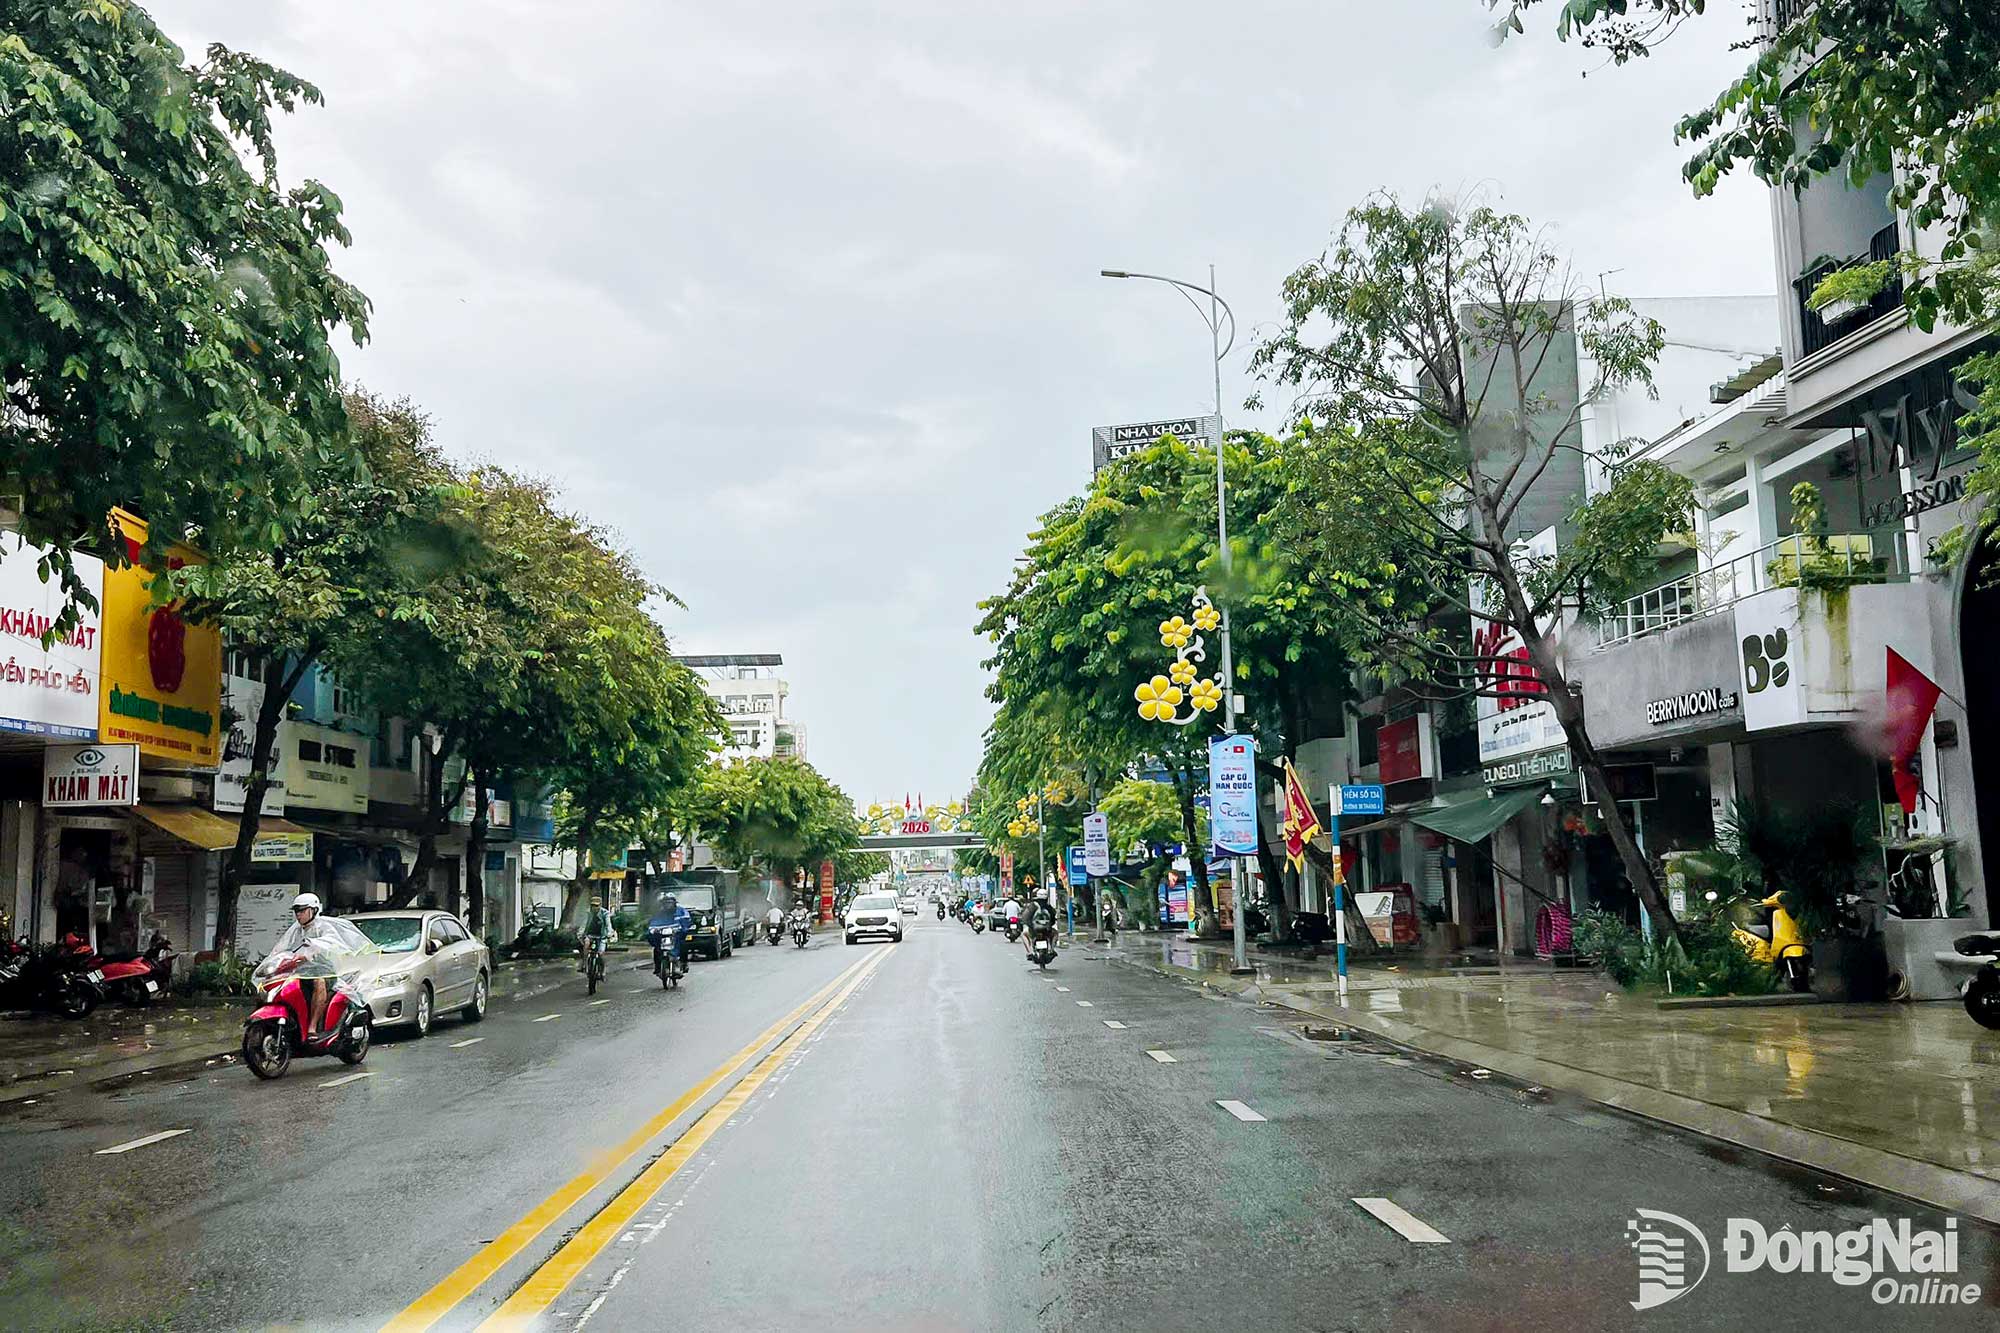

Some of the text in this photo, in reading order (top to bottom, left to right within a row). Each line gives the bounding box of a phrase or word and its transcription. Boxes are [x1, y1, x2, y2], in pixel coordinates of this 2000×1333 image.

[1117, 422, 1194, 440] NHA KHOA
[0, 607, 51, 640] KHÁM
[28, 663, 63, 691] PHÚC
[1646, 686, 1717, 725] BERRYMOON
[1539, 753, 1567, 774] THAO
[48, 764, 129, 802] KHÁM MẮT
[1359, 788, 1369, 799] SỐ
[901, 821, 930, 834] 2026
